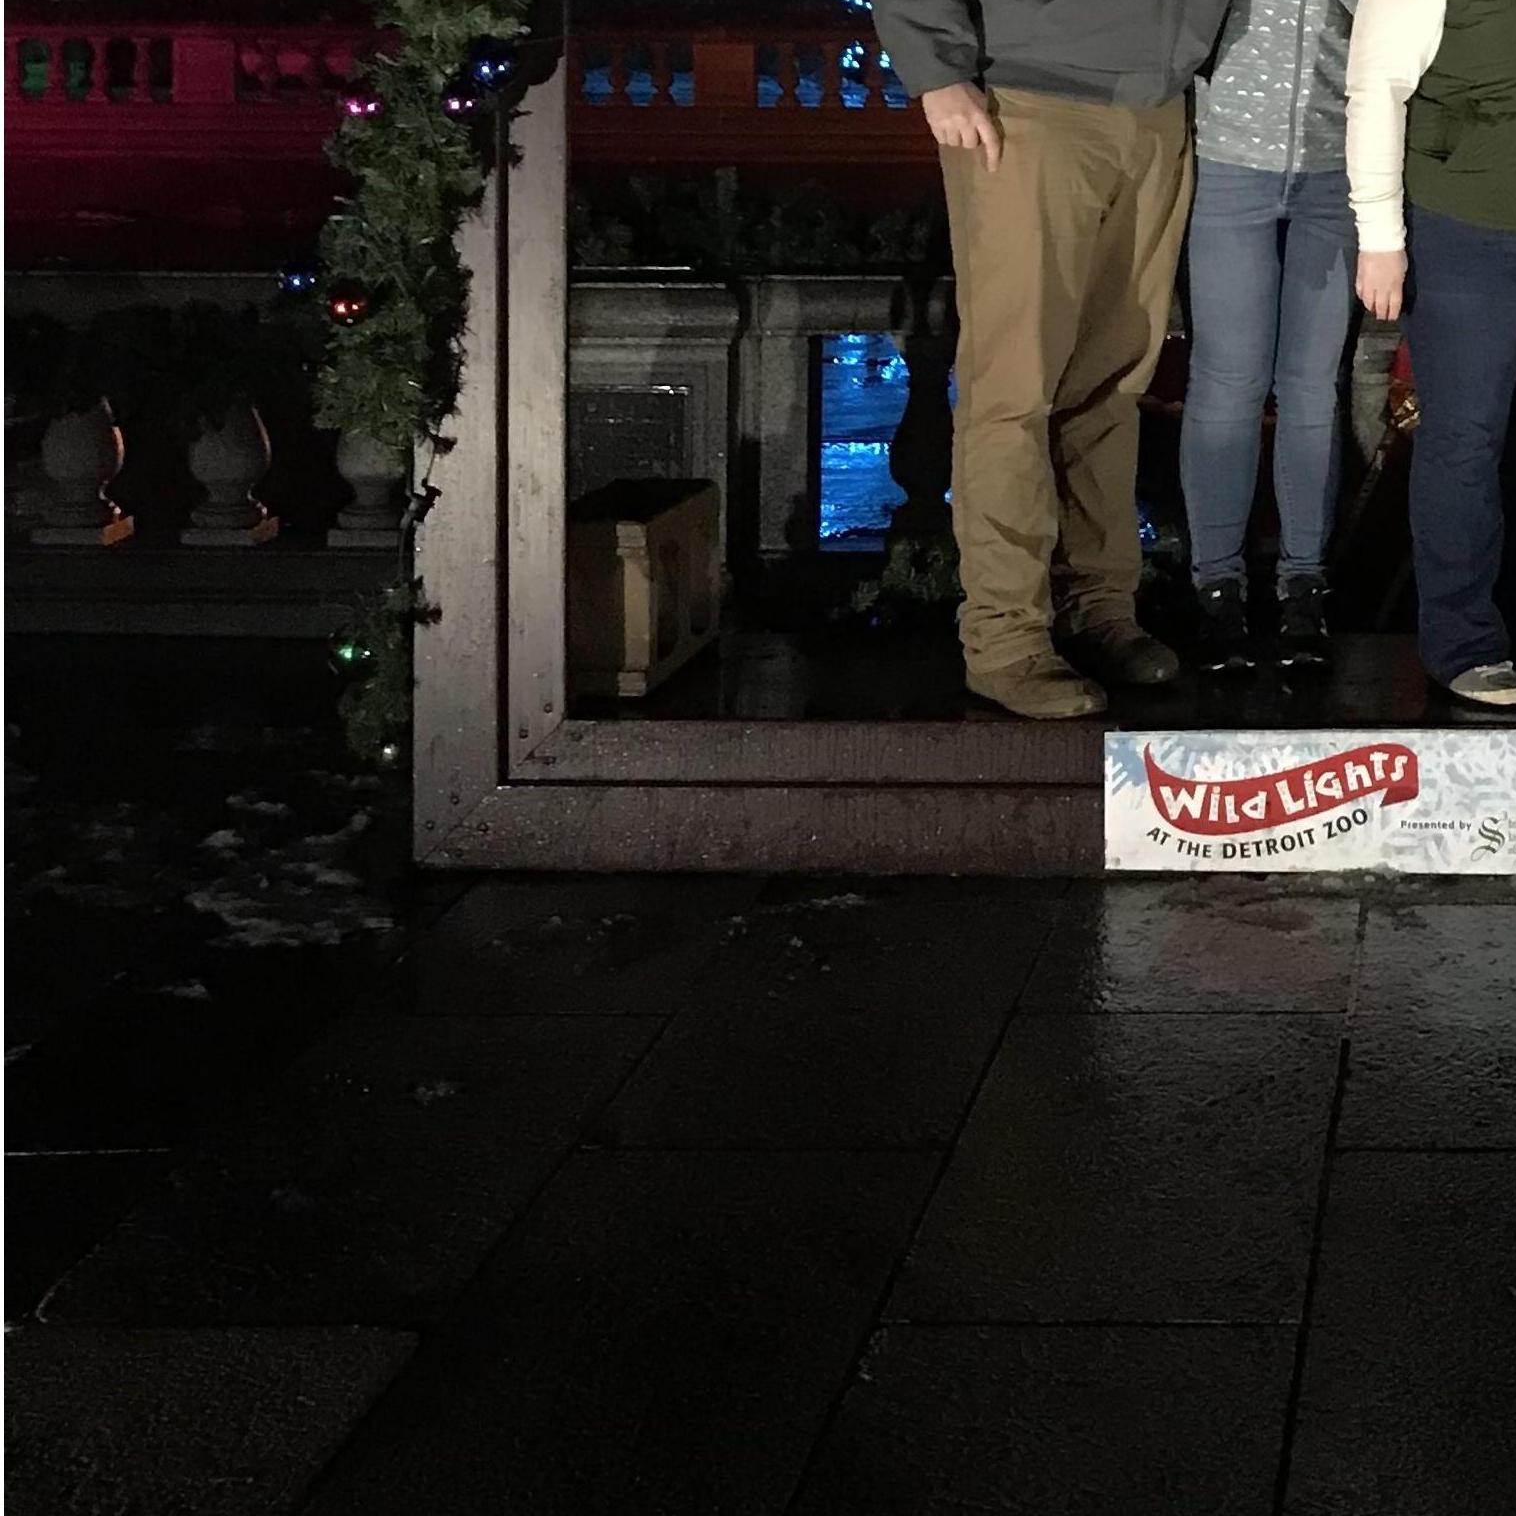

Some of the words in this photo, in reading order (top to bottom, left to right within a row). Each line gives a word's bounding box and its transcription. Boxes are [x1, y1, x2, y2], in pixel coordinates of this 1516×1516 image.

[1159, 783, 1267, 824] Wild
[1146, 826, 1172, 846] AT
[1177, 837, 1212, 858] THE
[1222, 828, 1316, 859] DETROIT
[1322, 808, 1369, 839] ZOO
[1400, 820, 1455, 830] Presented
[1459, 819, 1472, 832] by
